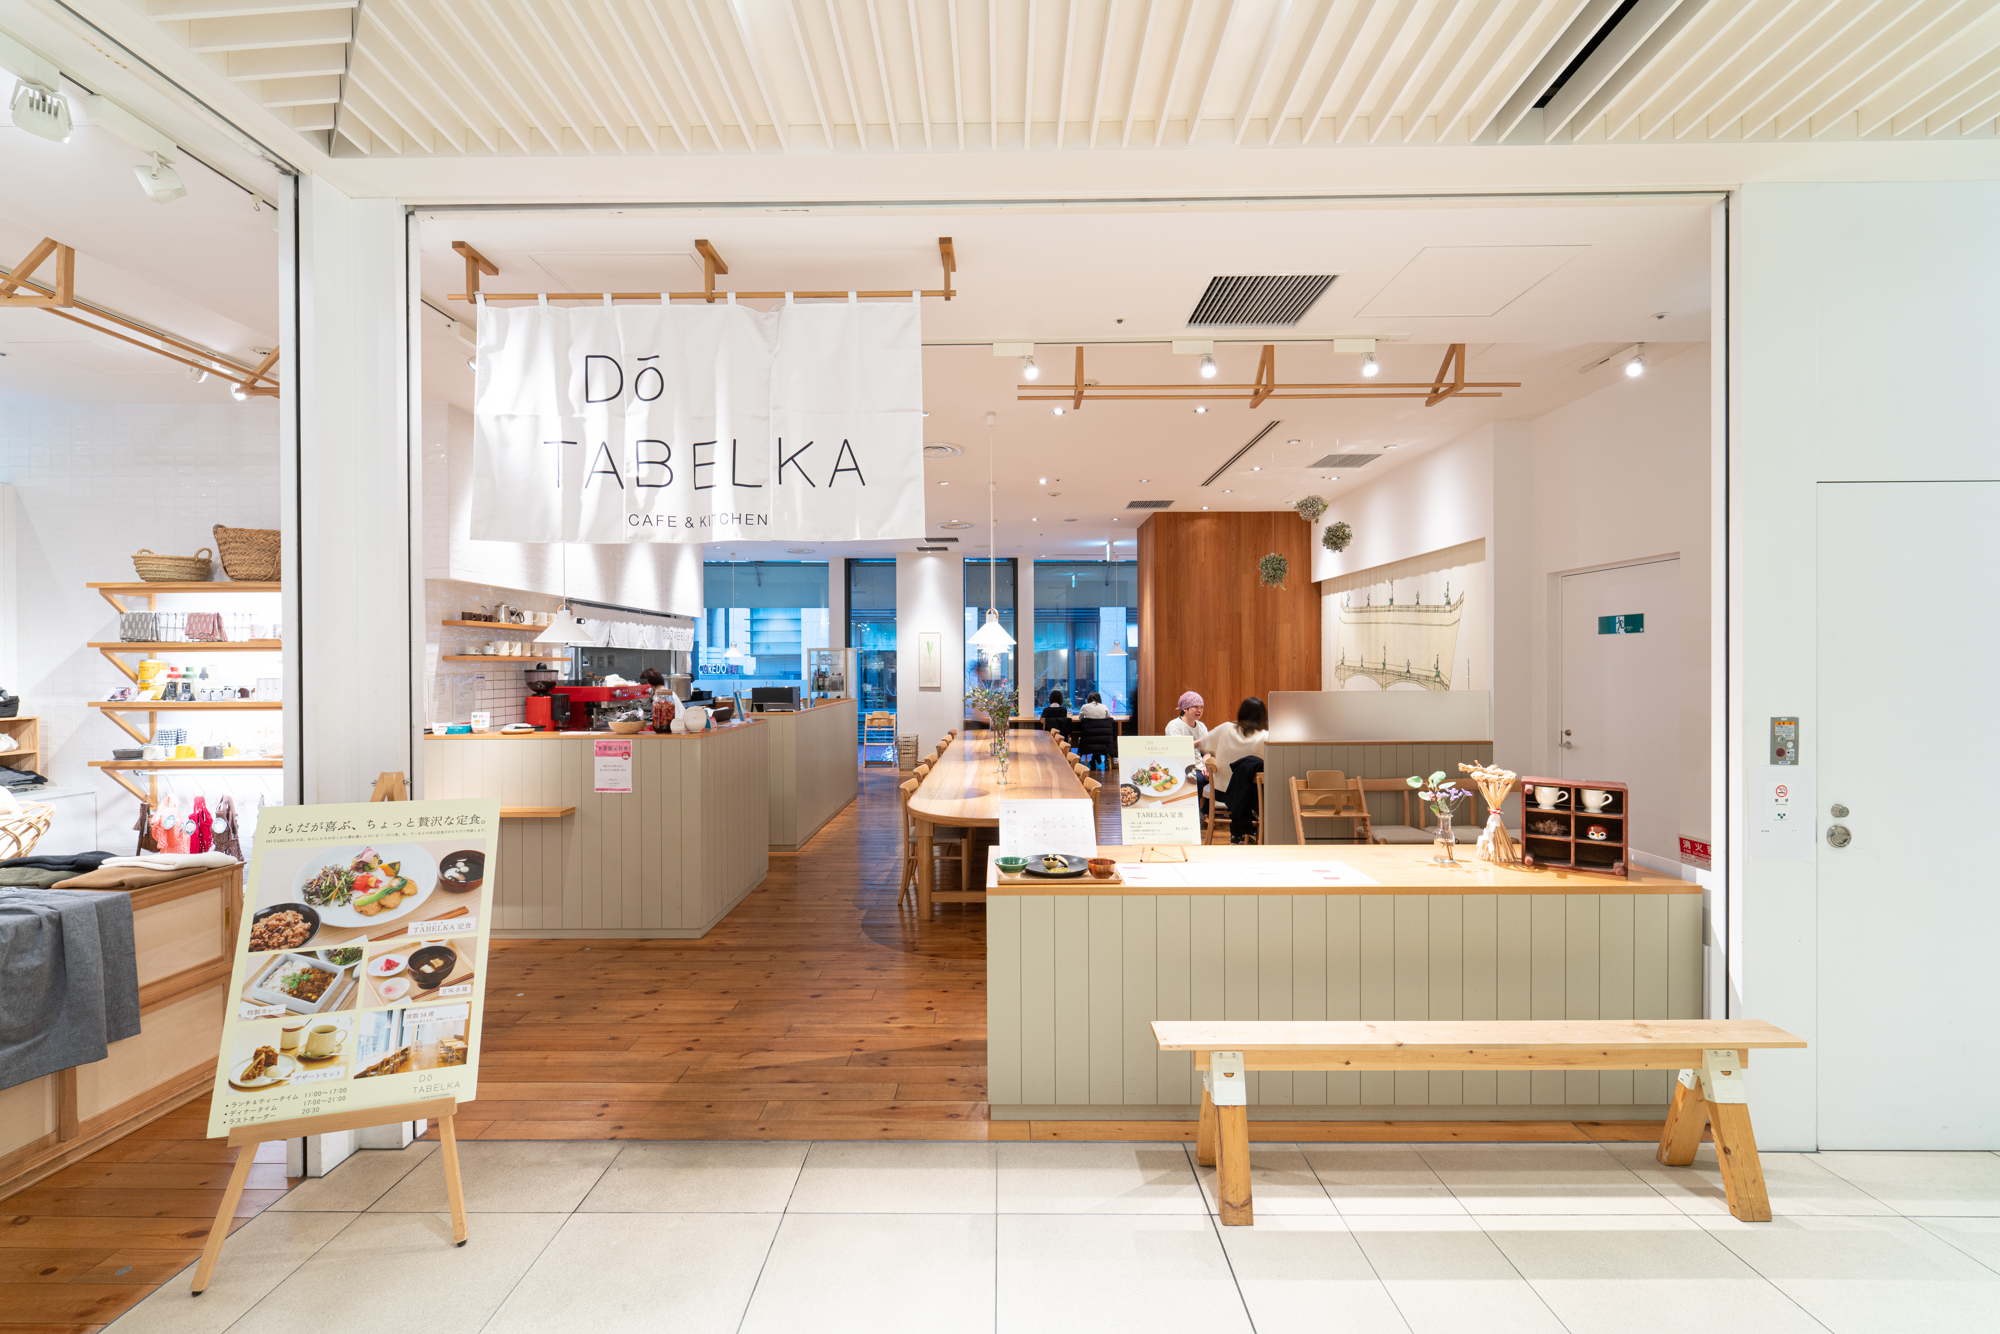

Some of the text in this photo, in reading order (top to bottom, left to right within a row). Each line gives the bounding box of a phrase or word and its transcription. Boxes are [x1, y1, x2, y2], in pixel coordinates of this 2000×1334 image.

[585, 354, 665, 404] Dō
[543, 437, 866, 490] TABELKA
[628, 512, 769, 529] CAFE & KITCHEN
[413, 924, 455, 934] TABELKA
[246, 1007, 282, 1016] 特製カレー
[294, 1070, 341, 1081] デザートセット
[419, 1073, 433, 1083] Dō
[412, 1081, 461, 1094] TABELKA
[301, 1106, 320, 1115] 20:30
